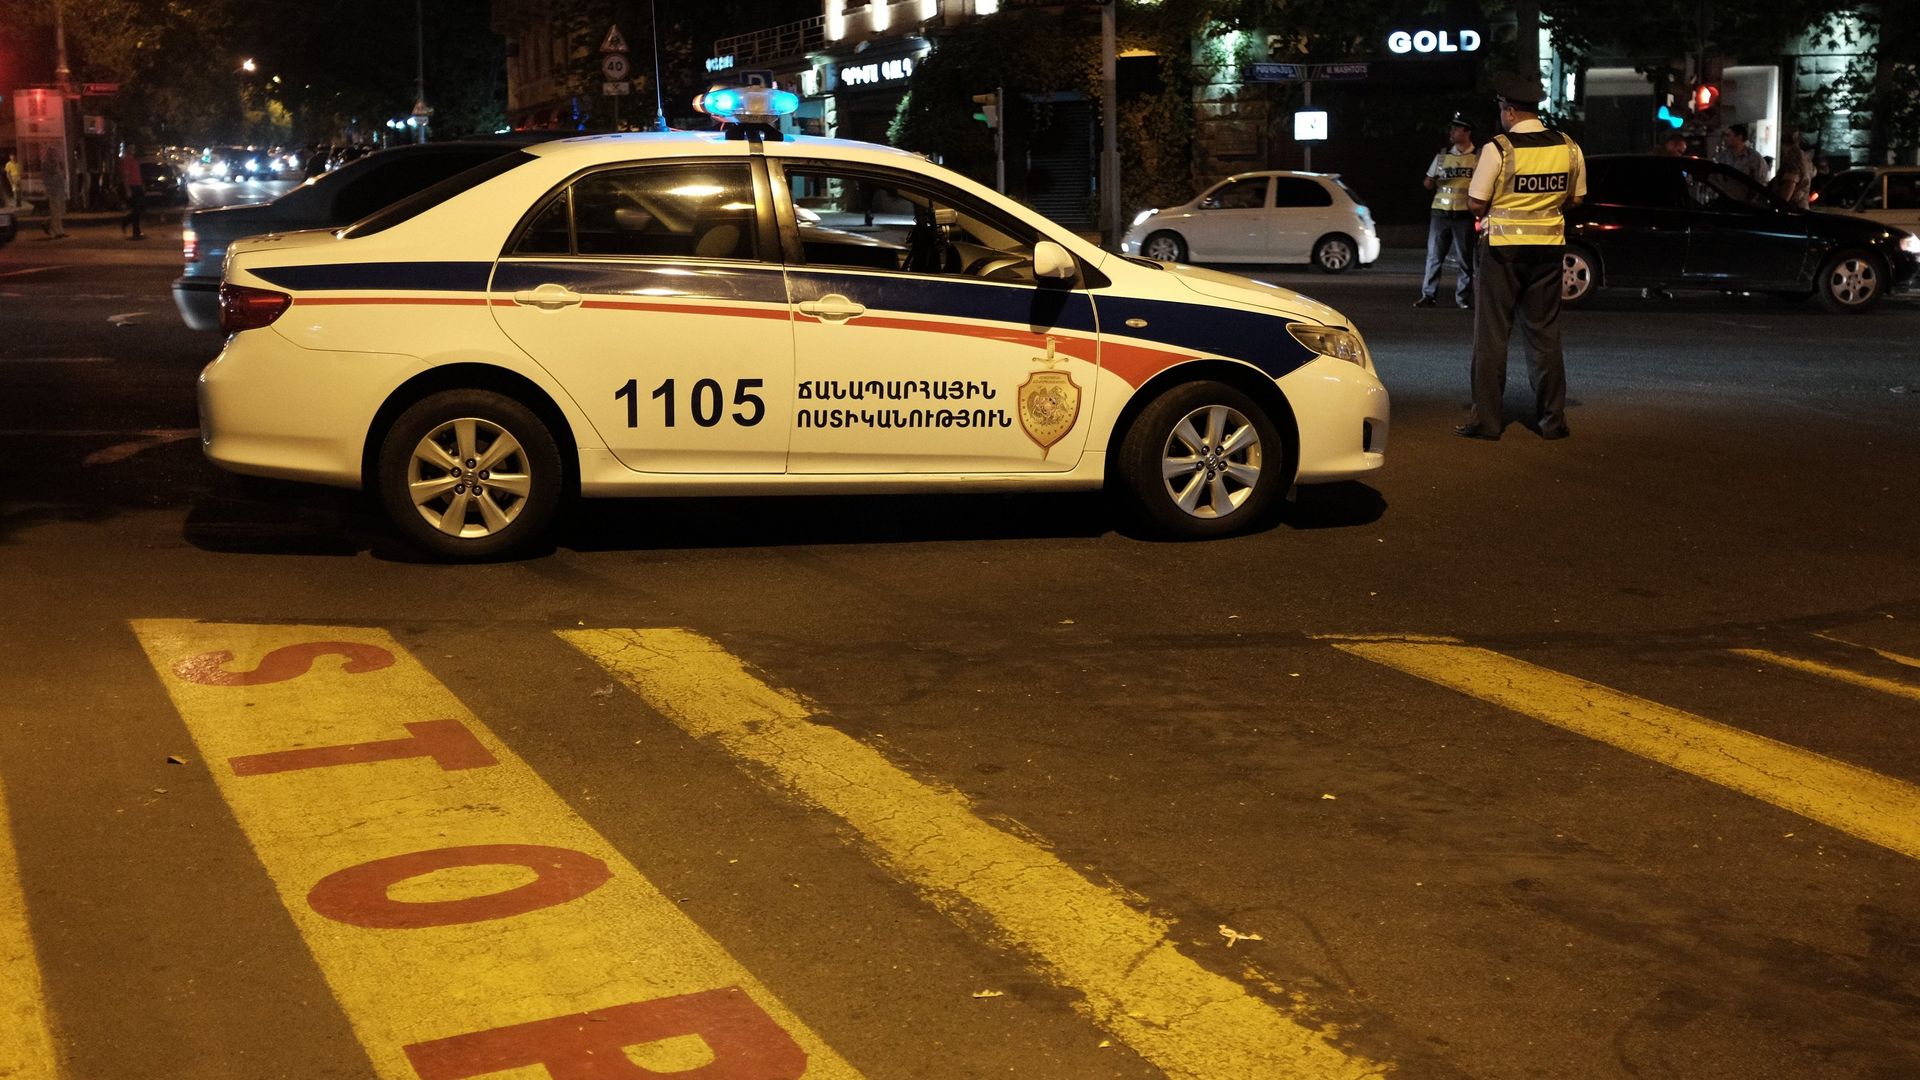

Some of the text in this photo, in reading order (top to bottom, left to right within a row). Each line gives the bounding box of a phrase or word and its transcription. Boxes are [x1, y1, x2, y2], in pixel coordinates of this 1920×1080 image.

[1388, 29, 1481, 54] GOLD
[607, 61, 623, 71] 40
[1518, 175, 1565, 191] POLICE
[797, 380, 997, 401] ՃԱՆԱՊԱՐՀԱՅԻՆ
[614, 378, 766, 429] 1105
[797, 408, 1013, 429] ՈՍՏԻԿԱՆՈՒԹՅՈՒՆ
[172, 641, 809, 1080] STOP
